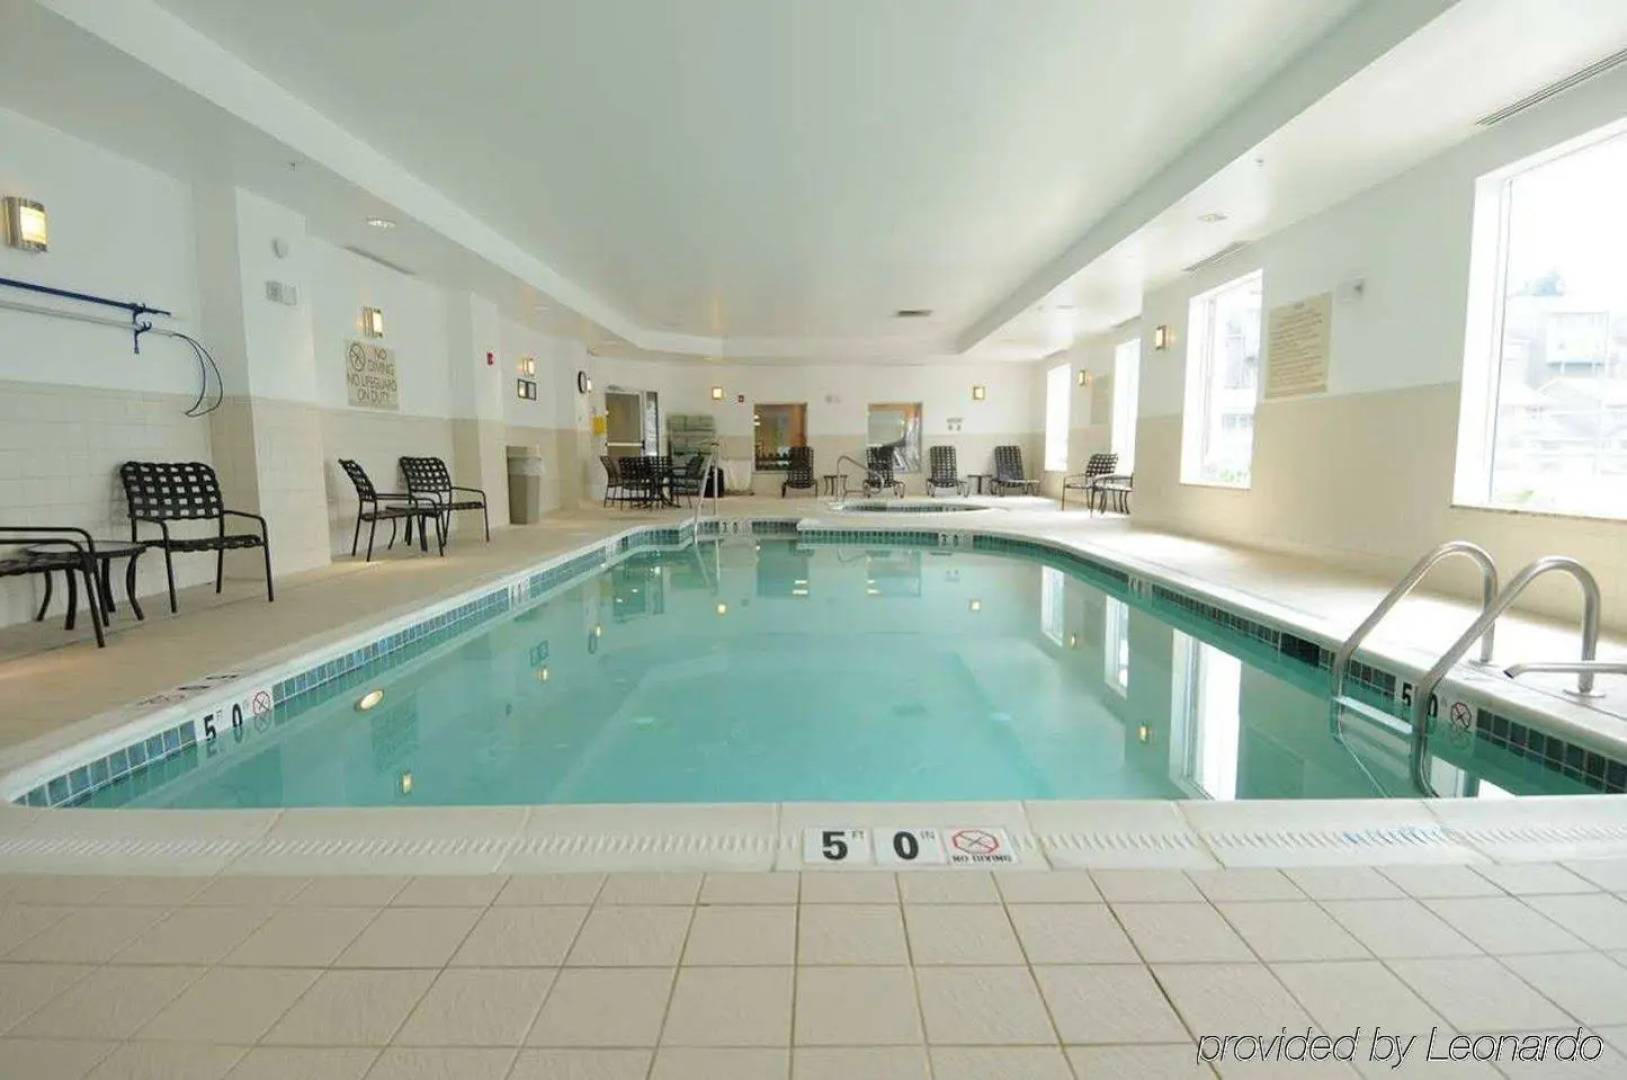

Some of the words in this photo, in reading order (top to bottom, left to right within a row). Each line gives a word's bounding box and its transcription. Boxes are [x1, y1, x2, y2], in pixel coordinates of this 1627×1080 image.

[1402, 682, 1413, 707] 5
[203, 713, 217, 741] 5
[231, 703, 243, 728] 0
[822, 830, 849, 860] 5
[893, 830, 919, 860] 0
[952, 855, 969, 863] NO
[972, 854, 1013, 864] DIVING
